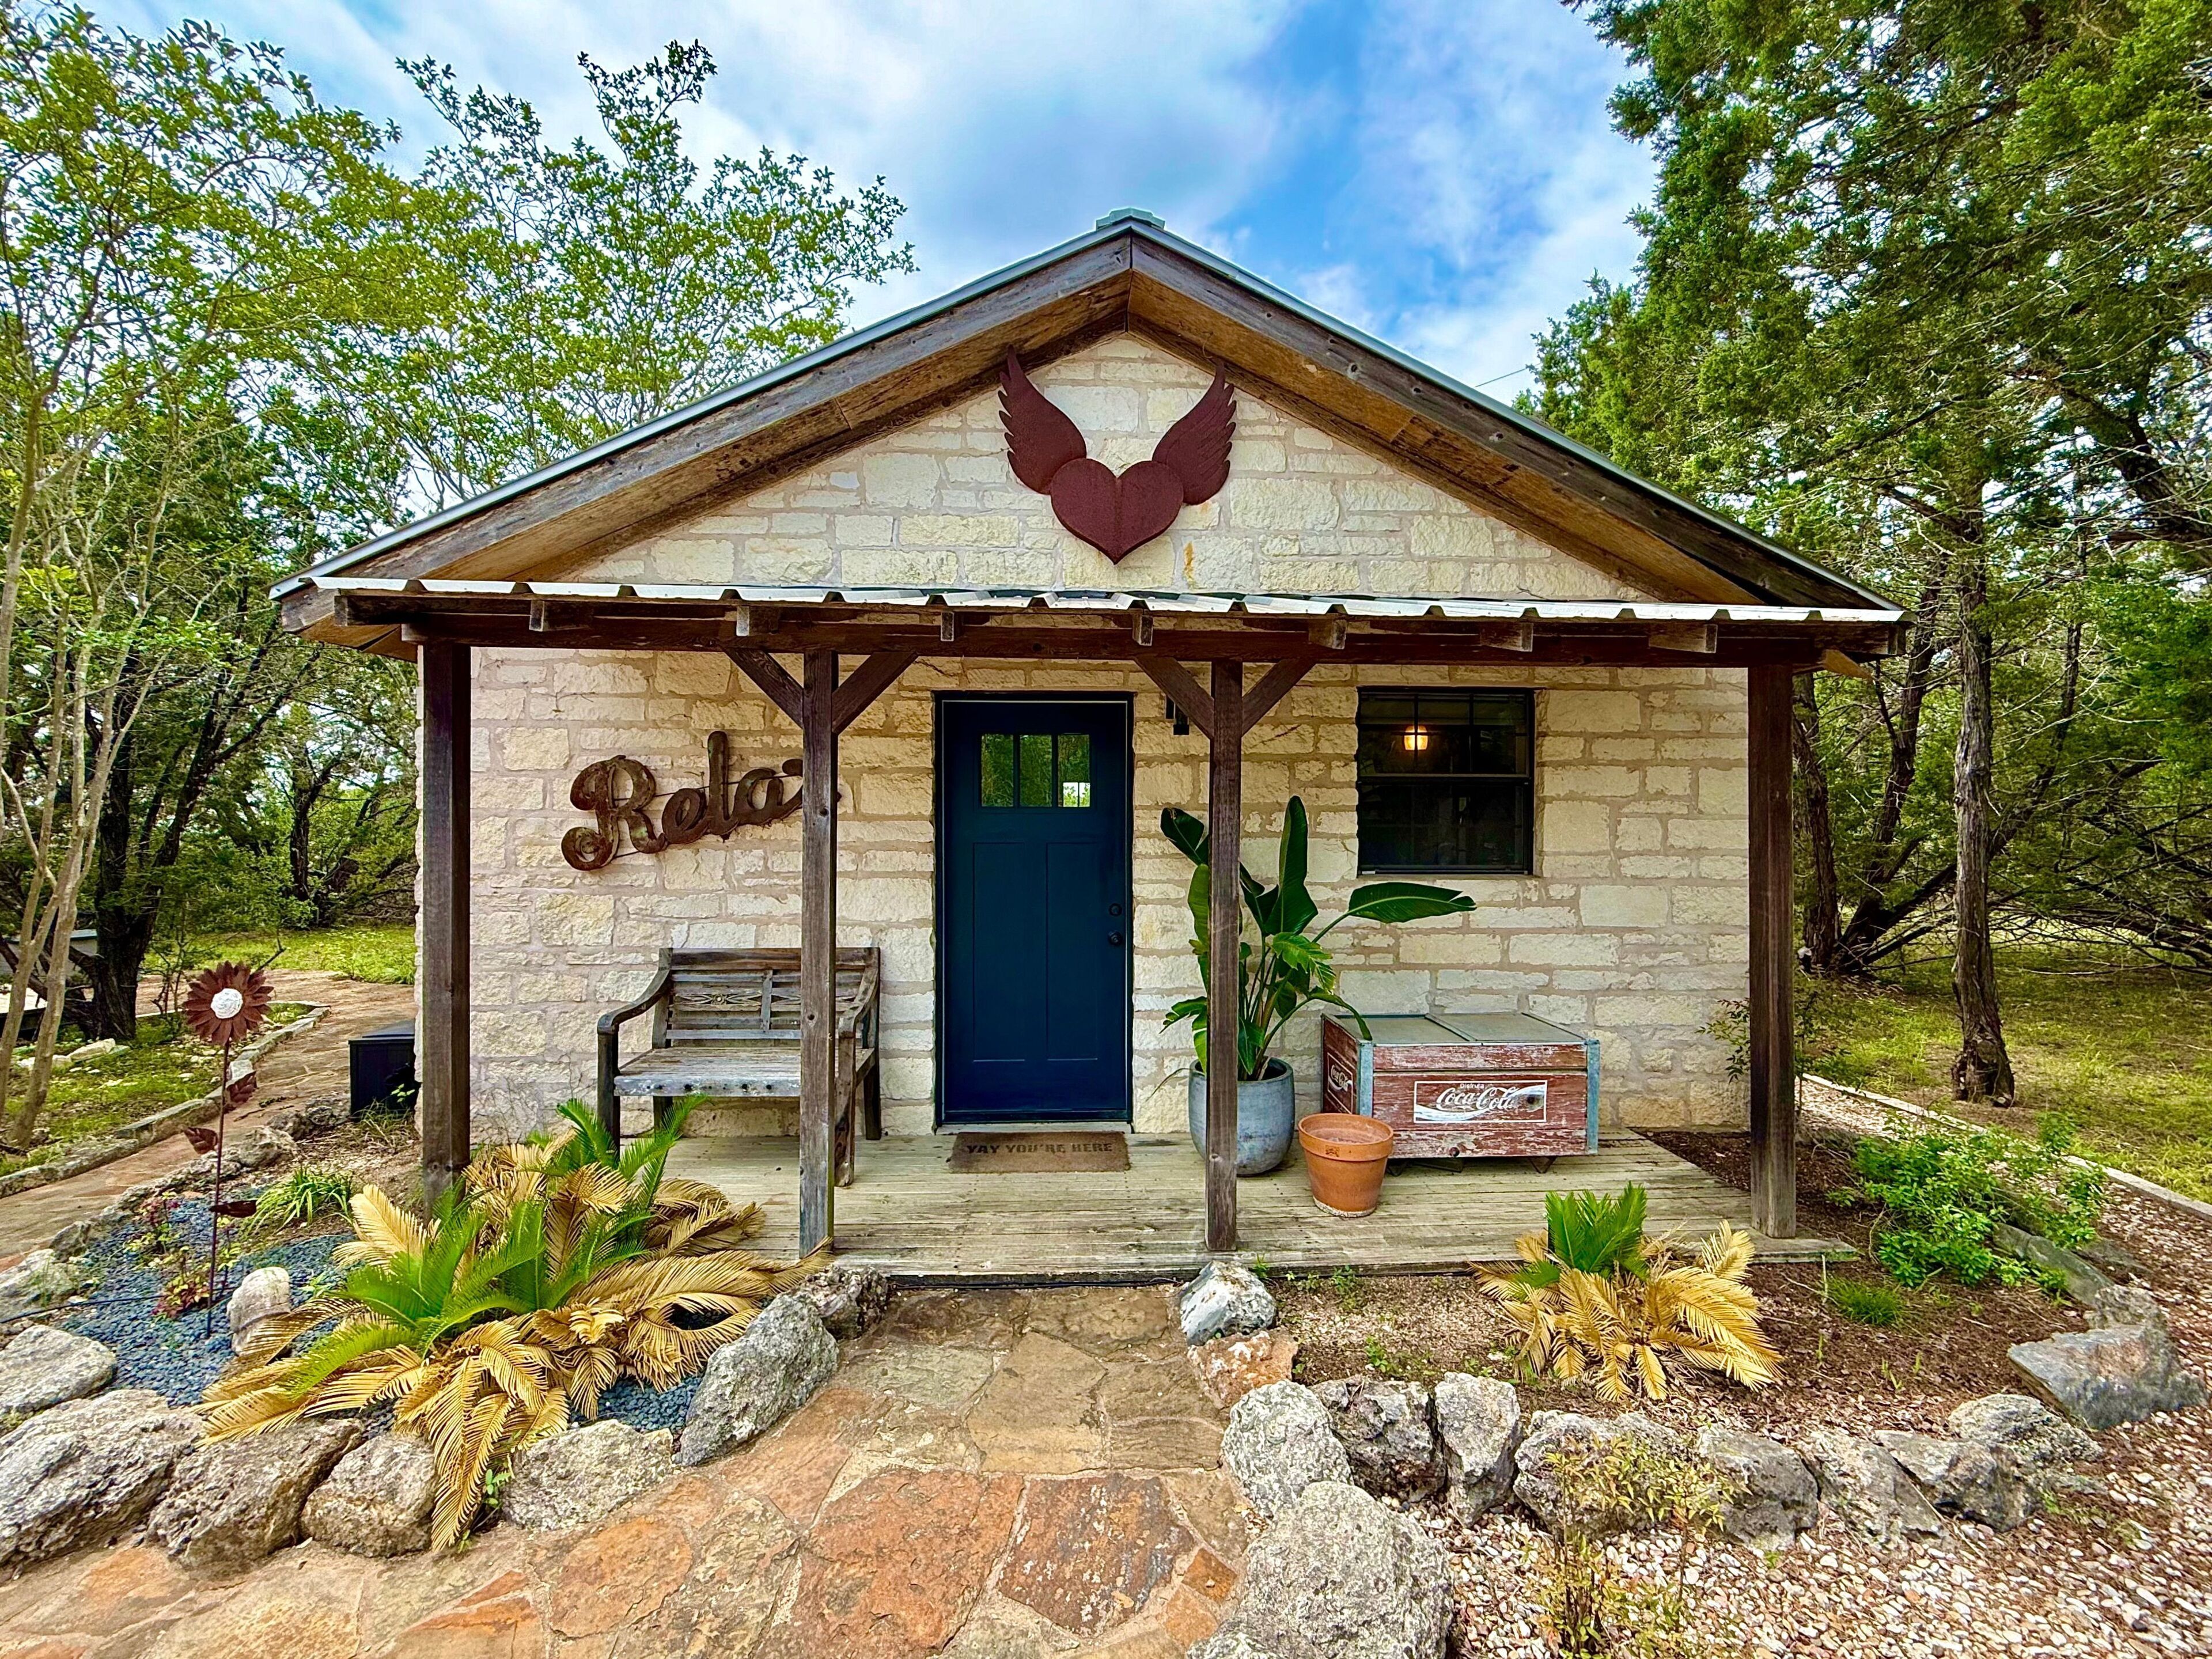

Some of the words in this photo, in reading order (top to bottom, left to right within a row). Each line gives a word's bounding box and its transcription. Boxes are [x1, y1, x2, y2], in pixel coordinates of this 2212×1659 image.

[1436, 1086, 1519, 1110] Coca-Cola
[967, 1145, 999, 1154] YAY
[1006, 1144, 1065, 1154] YOU'RE
[1072, 1143, 1113, 1152] HERE
